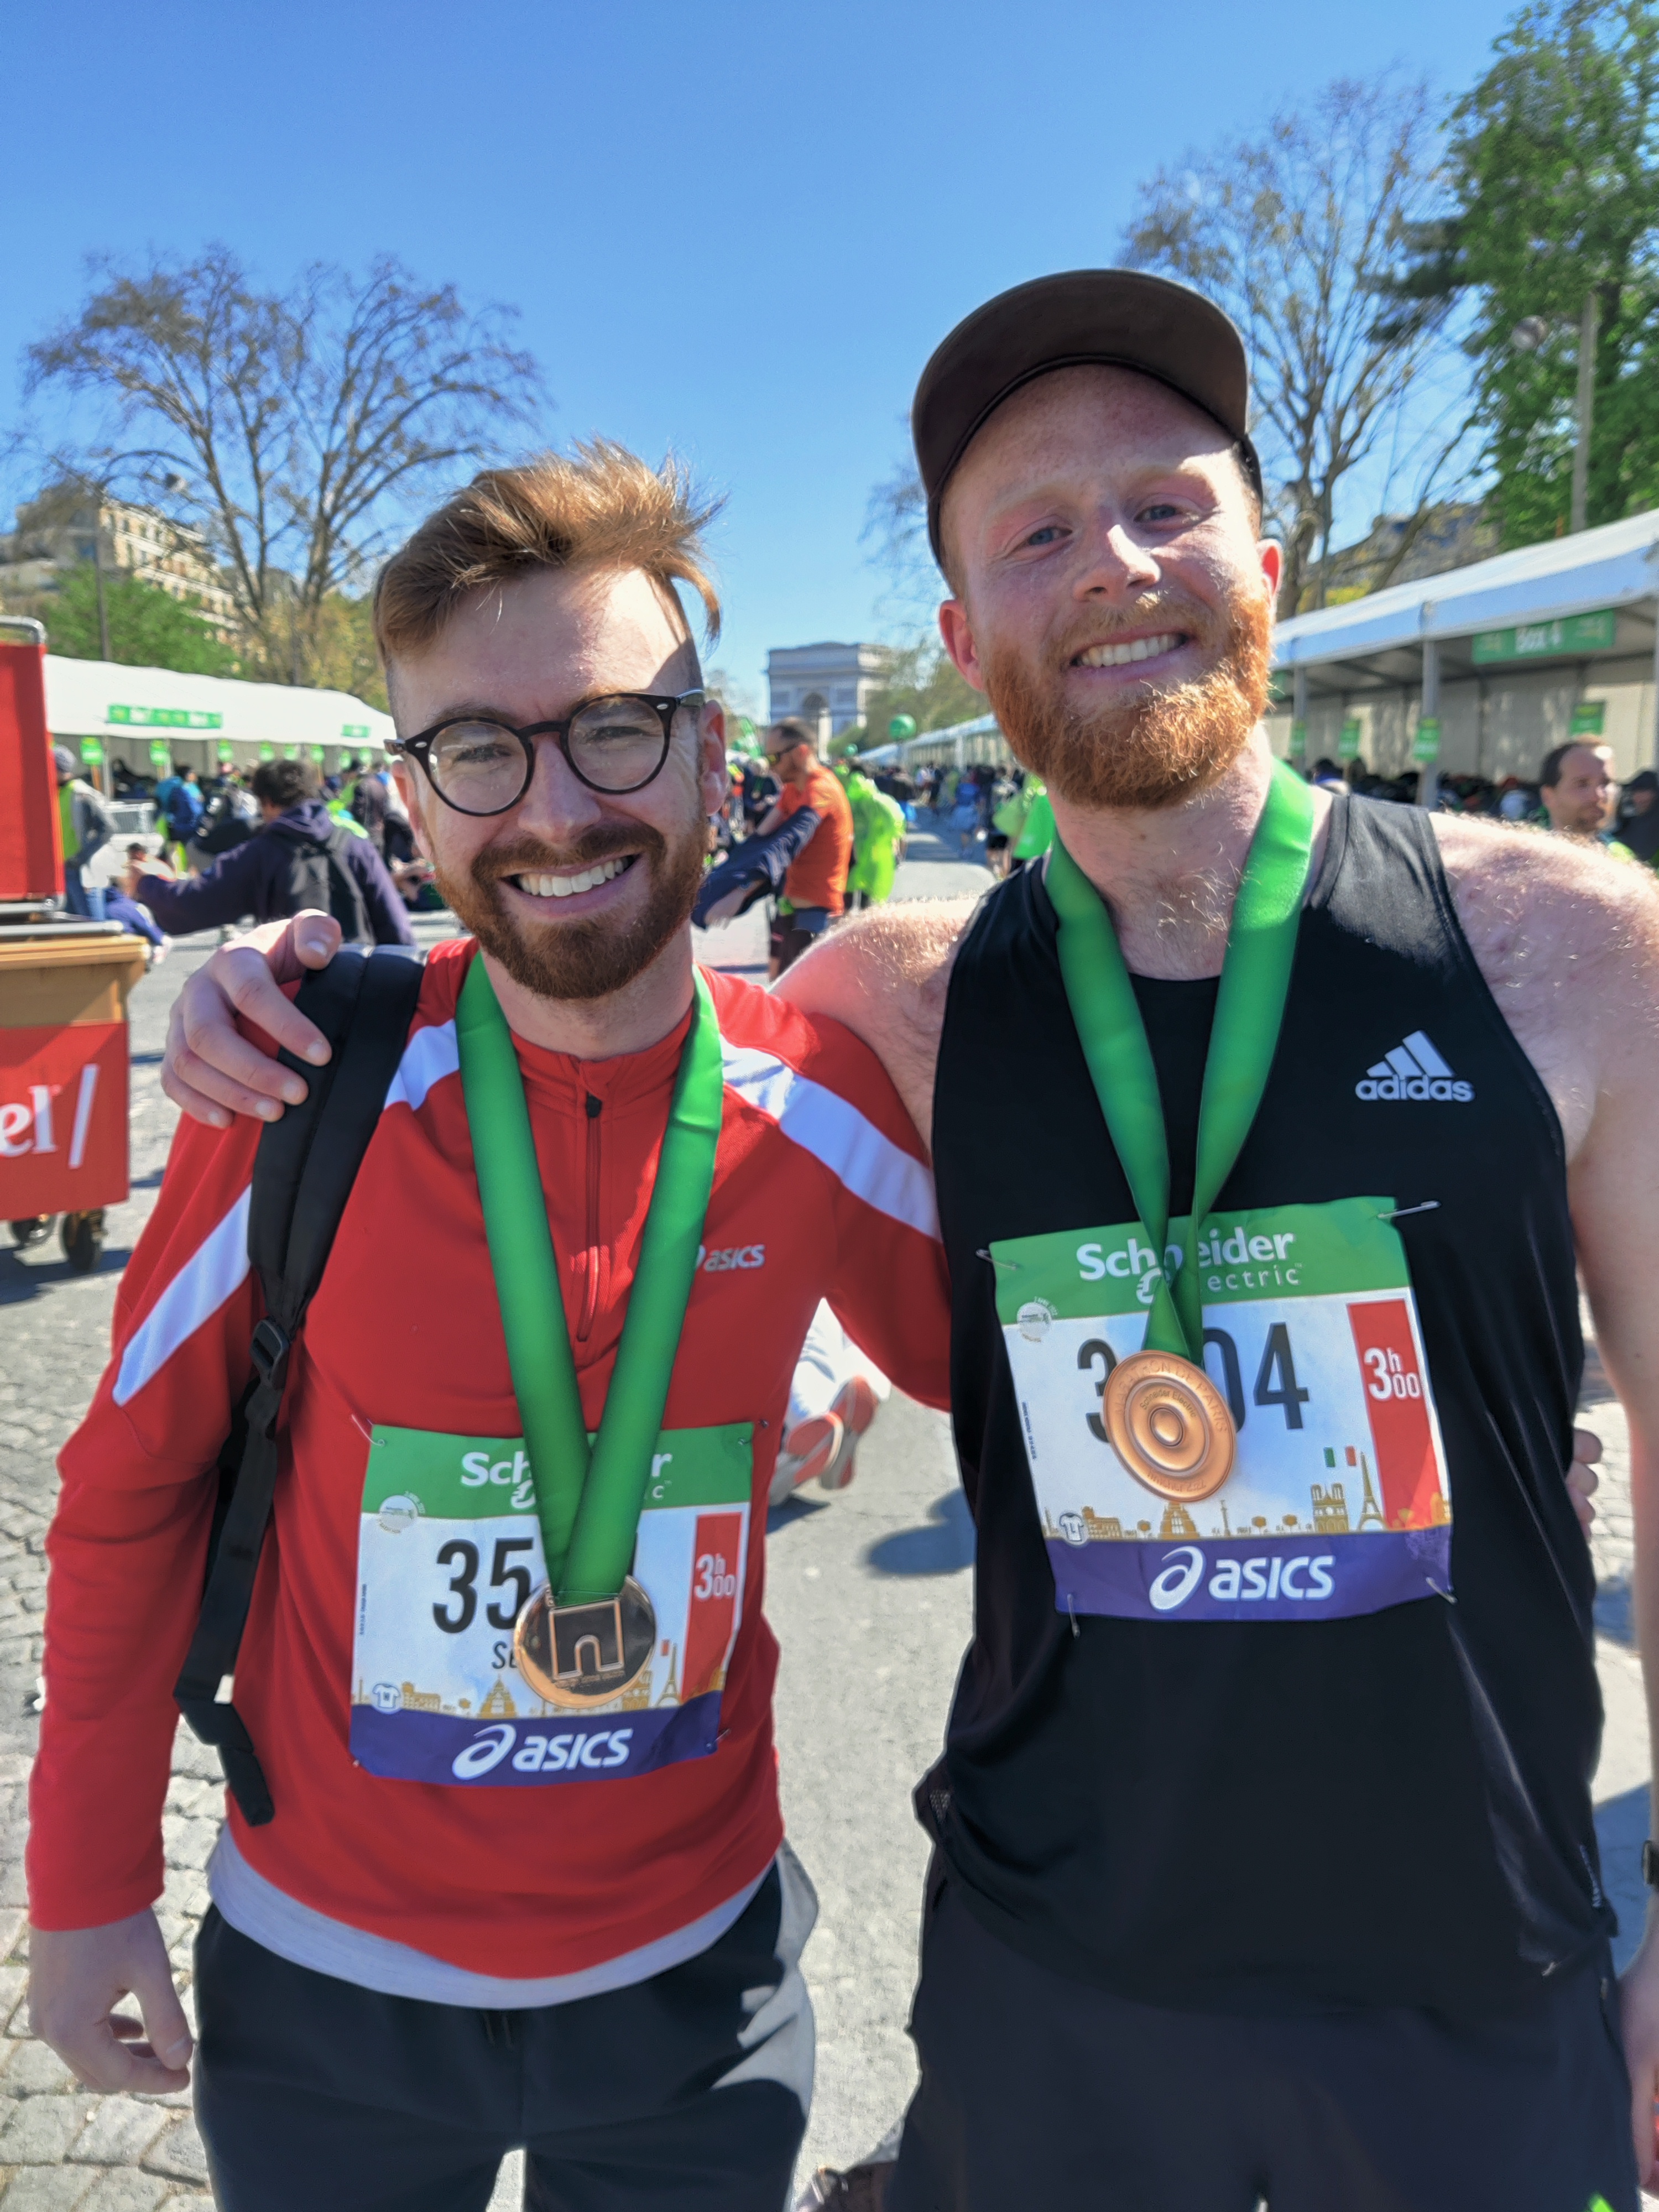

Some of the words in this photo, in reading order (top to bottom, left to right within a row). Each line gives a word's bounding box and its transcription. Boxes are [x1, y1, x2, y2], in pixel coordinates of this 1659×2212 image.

[1355, 1074, 1476, 1103] adidas
[1207, 1264, 1301, 1293] ectric
[1077, 1321, 1311, 1443] 304
[1139, 1390, 1171, 1411] Schneider
[1172, 1391, 1197, 1418] Electric
[433, 1536, 534, 1634] 35
[1208, 1554, 1336, 1601] asics
[512, 1728, 634, 1773] asics
